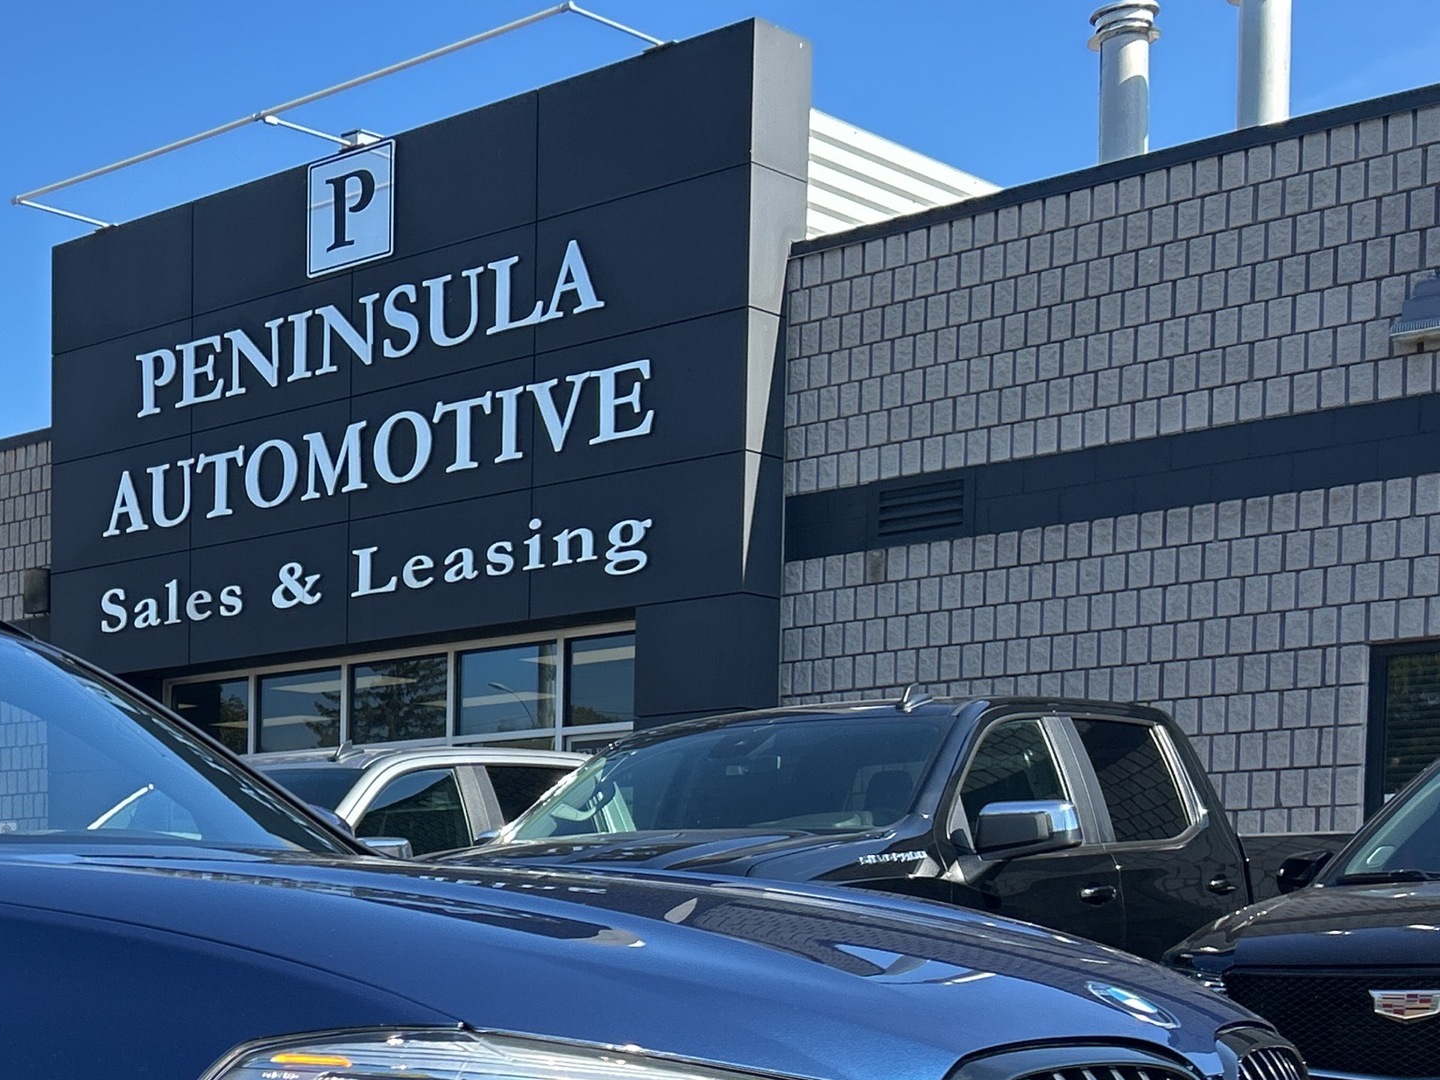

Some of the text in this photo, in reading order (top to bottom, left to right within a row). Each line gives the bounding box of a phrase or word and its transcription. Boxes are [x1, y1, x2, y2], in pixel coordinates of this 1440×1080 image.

[325, 167, 376, 253] P
[136, 239, 605, 418] PENINSULA
[102, 359, 655, 538] AUTOMOTIVE
[100, 518, 653, 634] Sales & Leasing
